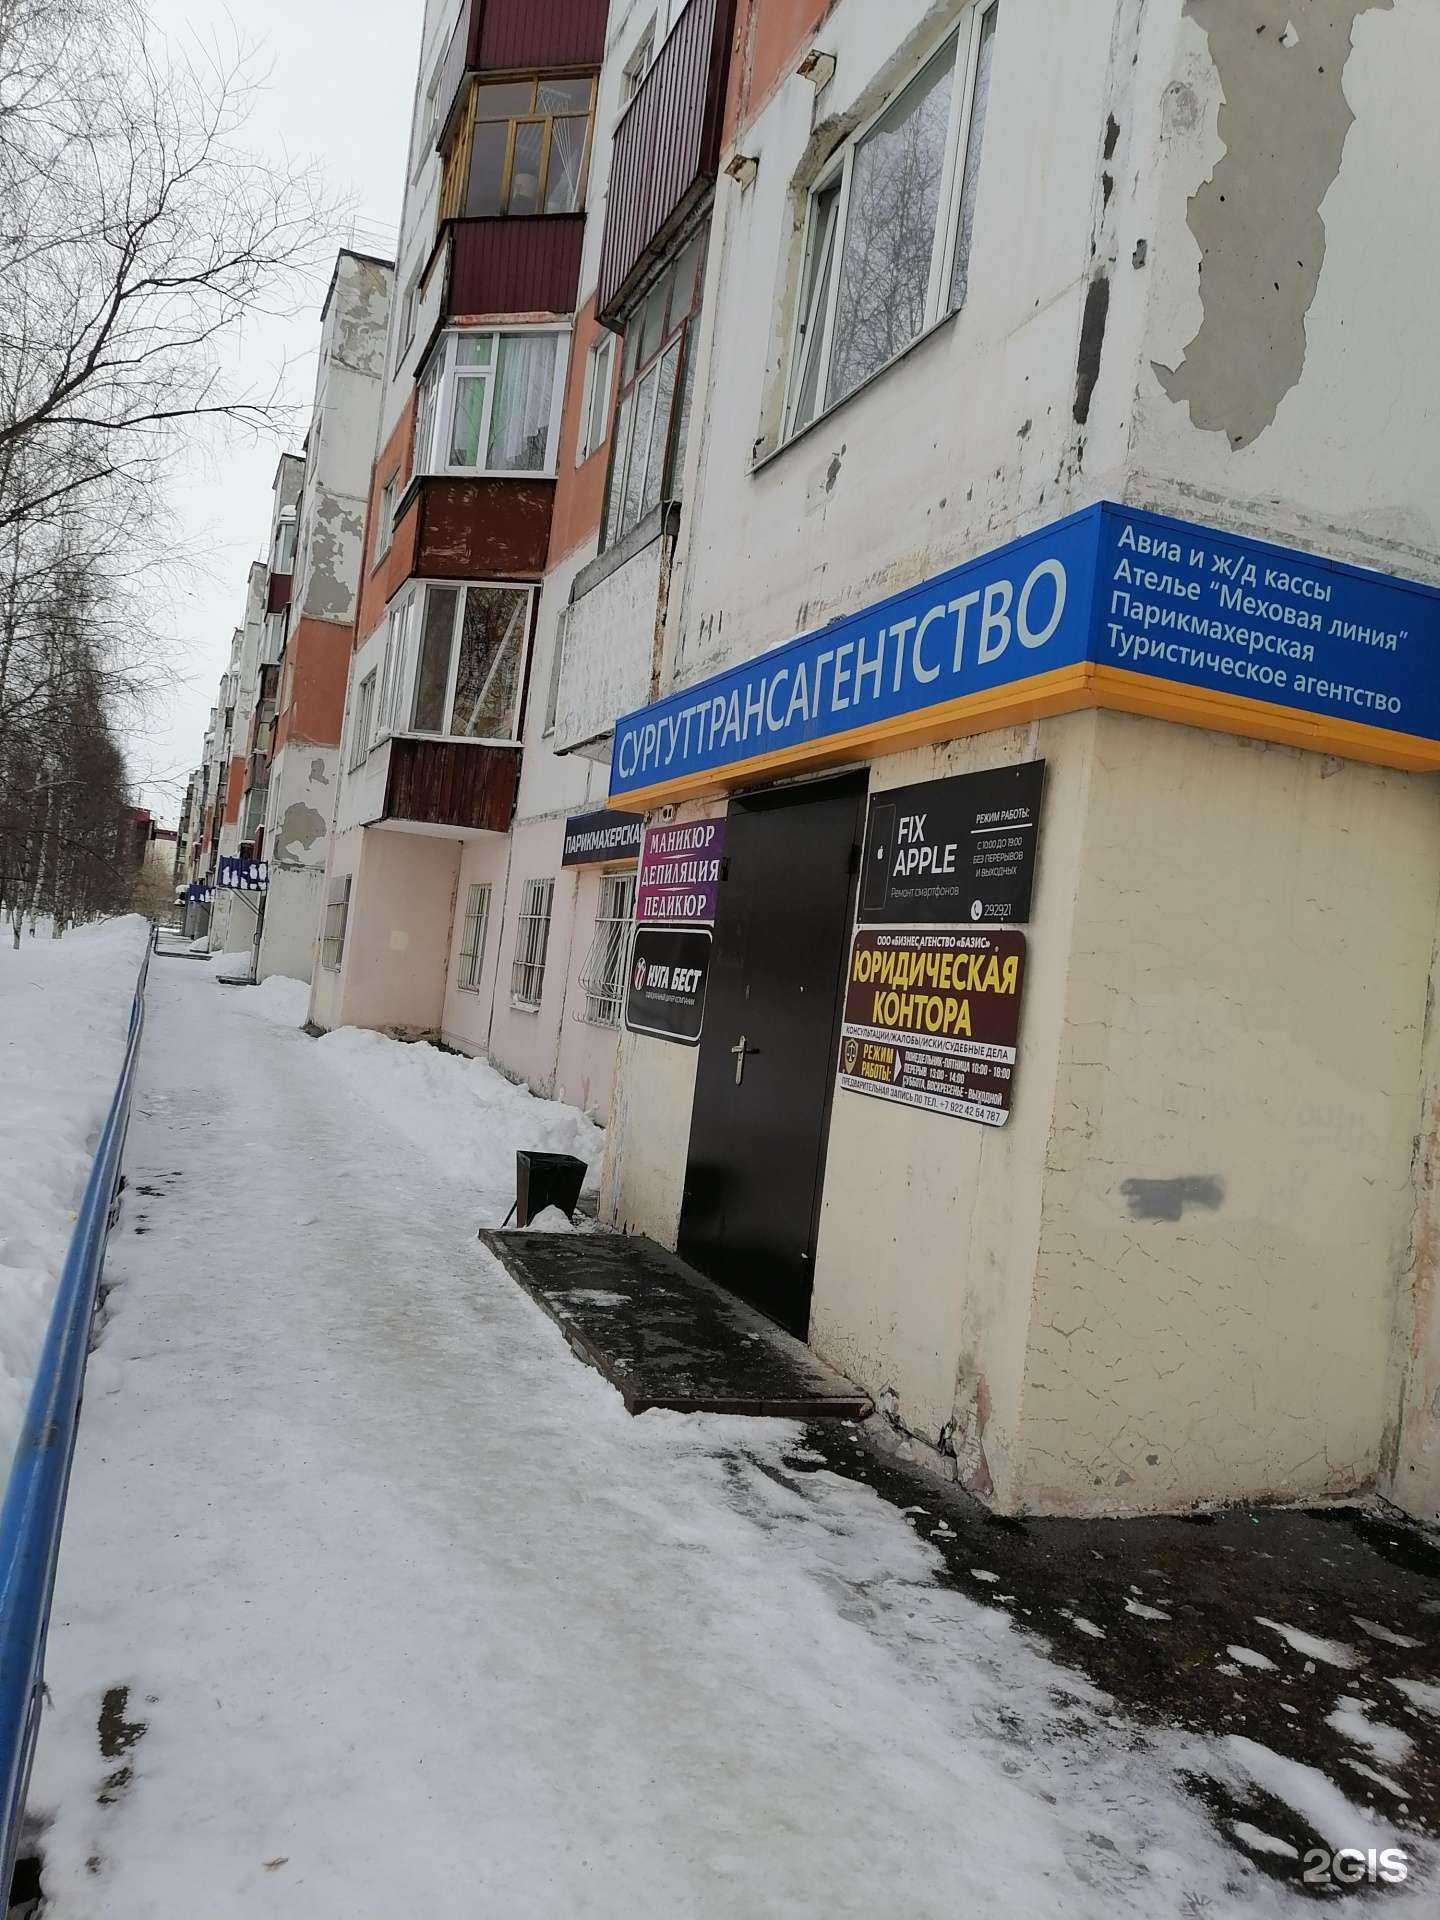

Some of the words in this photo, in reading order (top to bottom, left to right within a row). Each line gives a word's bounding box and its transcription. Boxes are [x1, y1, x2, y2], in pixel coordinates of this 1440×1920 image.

[1118, 525, 1181, 562] Авиа
[1189, 549, 1204, 568] и
[1212, 553, 1257, 588] ж/д
[1265, 569, 1331, 602] кассы
[1113, 558, 1201, 601] Ателье
[1110, 590, 1315, 663] Парикмахерская
[618, 558, 1067, 779] СУРГУТТРАНСАГЕНТСТВО
[1107, 623, 1287, 688] Туристическое
[1294, 674, 1402, 715] агентство
[976, 811, 1000, 824] РЕЖИМ
[1001, 807, 1031, 821] РАБОТЫ:
[650, 825, 715, 855] МАНИКЮР
[897, 814, 928, 845] FIX
[973, 853, 985, 865] БЕЗ
[985, 850, 1024, 864] ПЕРЕРЫВОВ
[977, 840, 982, 850] С
[996, 838, 1007, 849] ДО
[641, 859, 720, 888] ДЕПИЛЯЦИЯ
[892, 843, 958, 877] APPLE
[975, 868, 981, 878] И
[981, 865, 1017, 878] ВЫХОДНЫХ
[644, 894, 707, 918] ПЕДИКЮР
[890, 887, 915, 898] Ремонт
[915, 886, 960, 899] смартфонов
[984, 904, 1012, 916] 292921
[877, 936, 891, 946] ООО
[919, 936, 955, 948] АГЕНСТВО
[956, 937, 990, 949] «БАЗИС»
[646, 965, 669, 989] НУГА
[671, 967, 702, 993] БЕСТ
[853, 950, 1019, 994] ЮРИДИЧЕСКАЯ
[872, 991, 972, 1036] КОНТОРА
[863, 1043, 894, 1064] РЕЖИМ
[986, 1048, 1009, 1060] ДЕЛА
[861, 1061, 892, 1081] РАБОТЫ:
[903, 1063, 928, 1077] ПЕРЕРЫВ
[841, 1076, 890, 1097] ПРЕДВАРИТЕЛЬНАЯ
[890, 1087, 914, 1101] ЗАПИСЬ
[914, 1093, 923, 1103] ПО
[923, 1095, 938, 1108] ТЕЛ.
[949, 1102, 964, 1114] 922
[964, 1105, 974, 1117] 42
[985, 1110, 1001, 1122] 787
[927, 1080, 964, 1097] ВОСКРЕСЕНЬЕ
[968, 1089, 1003, 1106] ВЫХОДНОЙ
